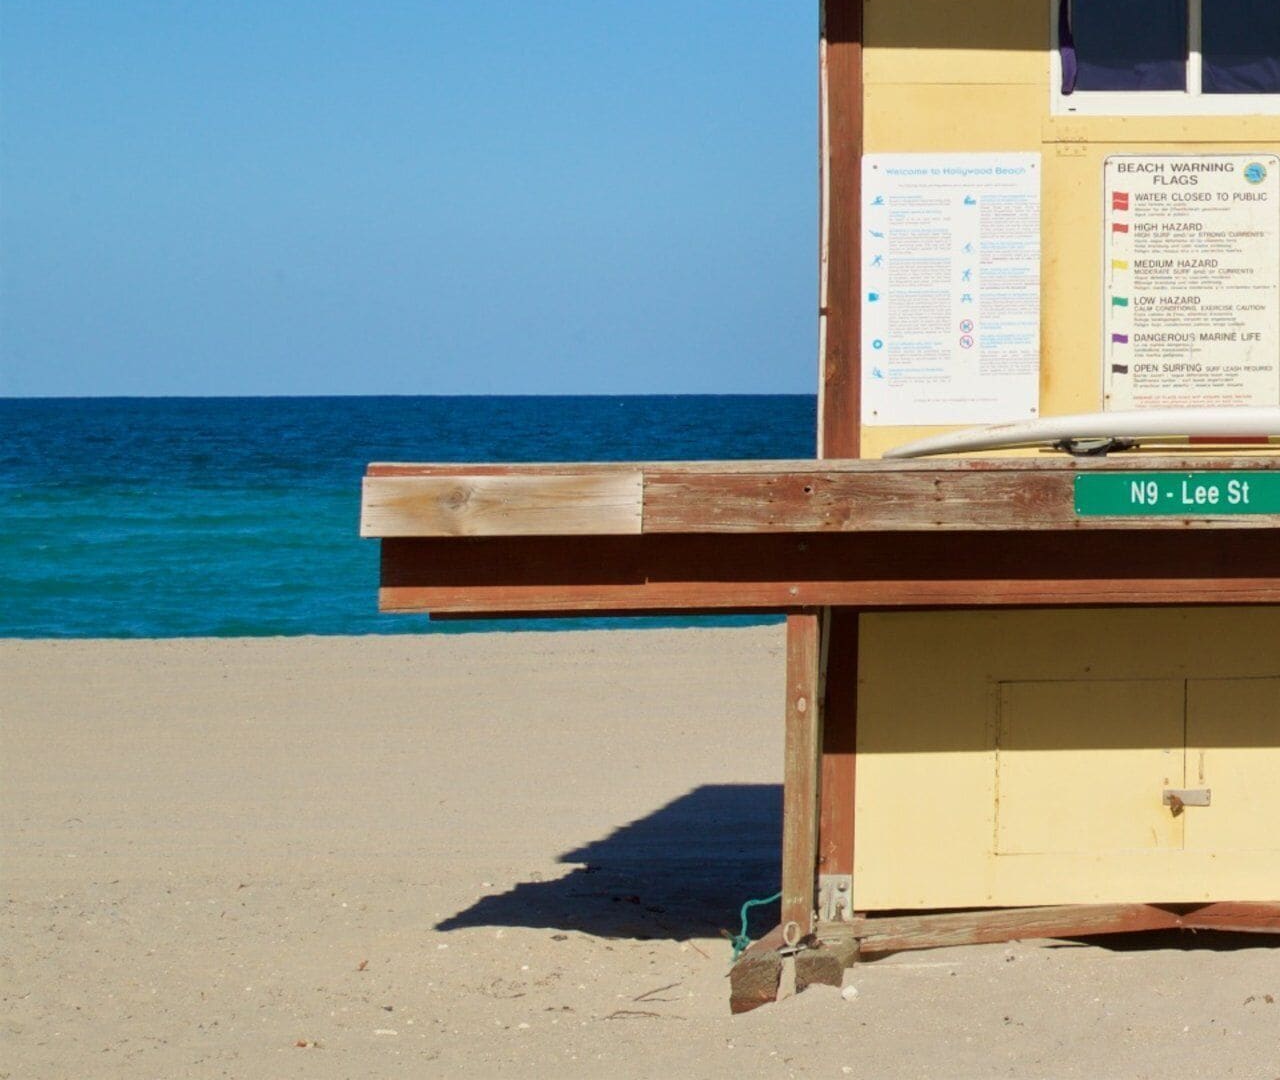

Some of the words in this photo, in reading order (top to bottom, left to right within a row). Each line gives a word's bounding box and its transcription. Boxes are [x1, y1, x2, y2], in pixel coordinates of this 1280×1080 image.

[944, 167, 992, 176] Hollywood
[1118, 163, 1164, 173] BEACH
[1171, 163, 1234, 172] WARNING
[1153, 175, 1198, 185] FLAGS
[1135, 193, 1167, 201] WATER
[1172, 192, 1212, 201] CLOSED
[1216, 192, 1228, 201] TO
[1233, 192, 1268, 201] PUBLIC
[1134, 223, 1158, 231] HIGH
[1162, 223, 1203, 231] HAZARD
[1134, 260, 1173, 268] MEDIUM
[1134, 297, 1156, 305] LOW
[1134, 334, 1195, 342] DANGEROUS
[1200, 333, 1237, 341] MARINE
[1241, 333, 1261, 341] LIFE
[1134, 364, 1158, 372] OPEN
[1162, 364, 1202, 372] SURFING
[1131, 481, 1158, 505] N9
[1182, 480, 1219, 504] Lee
[1227, 480, 1250, 504] St
